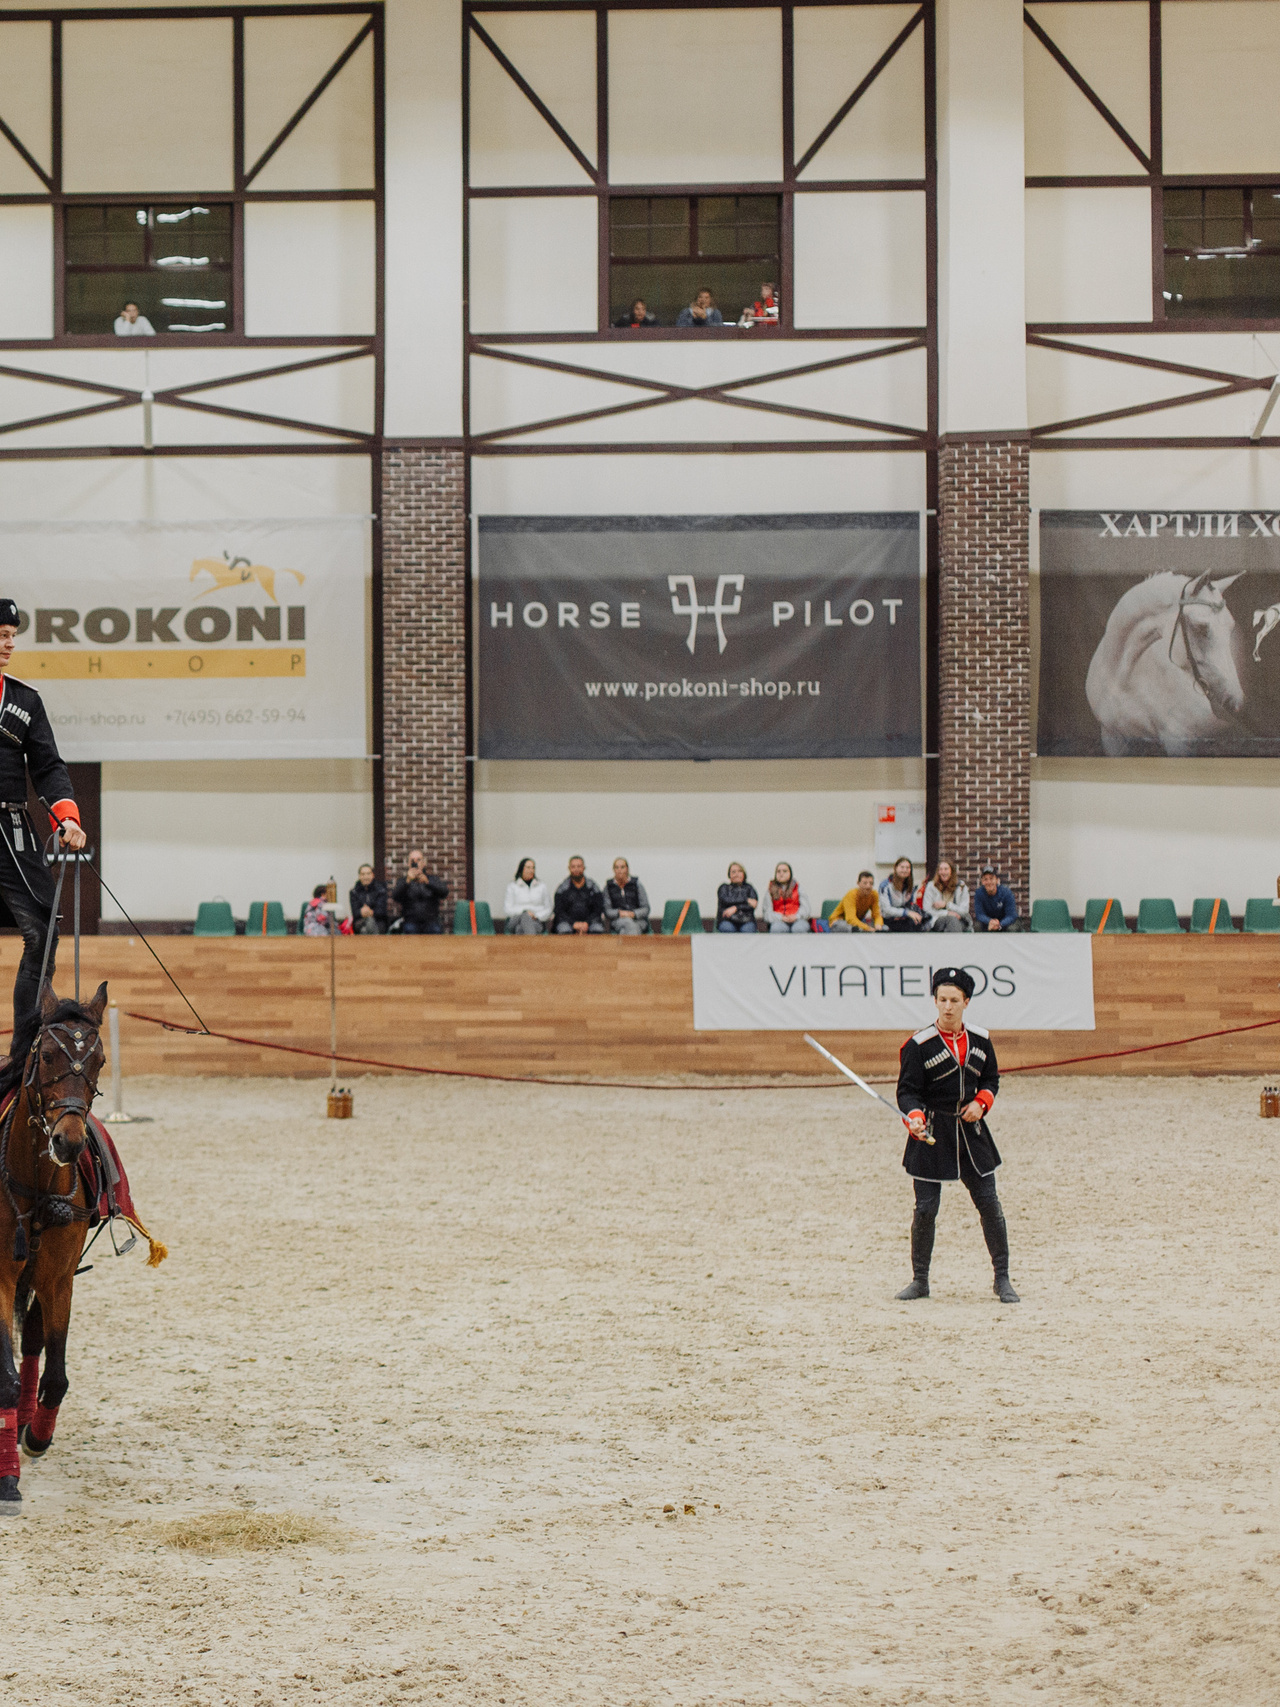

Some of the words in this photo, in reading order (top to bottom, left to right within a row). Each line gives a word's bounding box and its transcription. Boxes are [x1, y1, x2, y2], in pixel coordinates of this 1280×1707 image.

[1099, 513, 1241, 538] ХАРТЛИ
[17, 606, 306, 643] ROKONI
[490, 602, 641, 628] HORSE
[773, 599, 903, 626] PILOT
[585, 678, 821, 700] www.prokoni-shop.ru
[50, 710, 146, 727] koni-shop.ru
